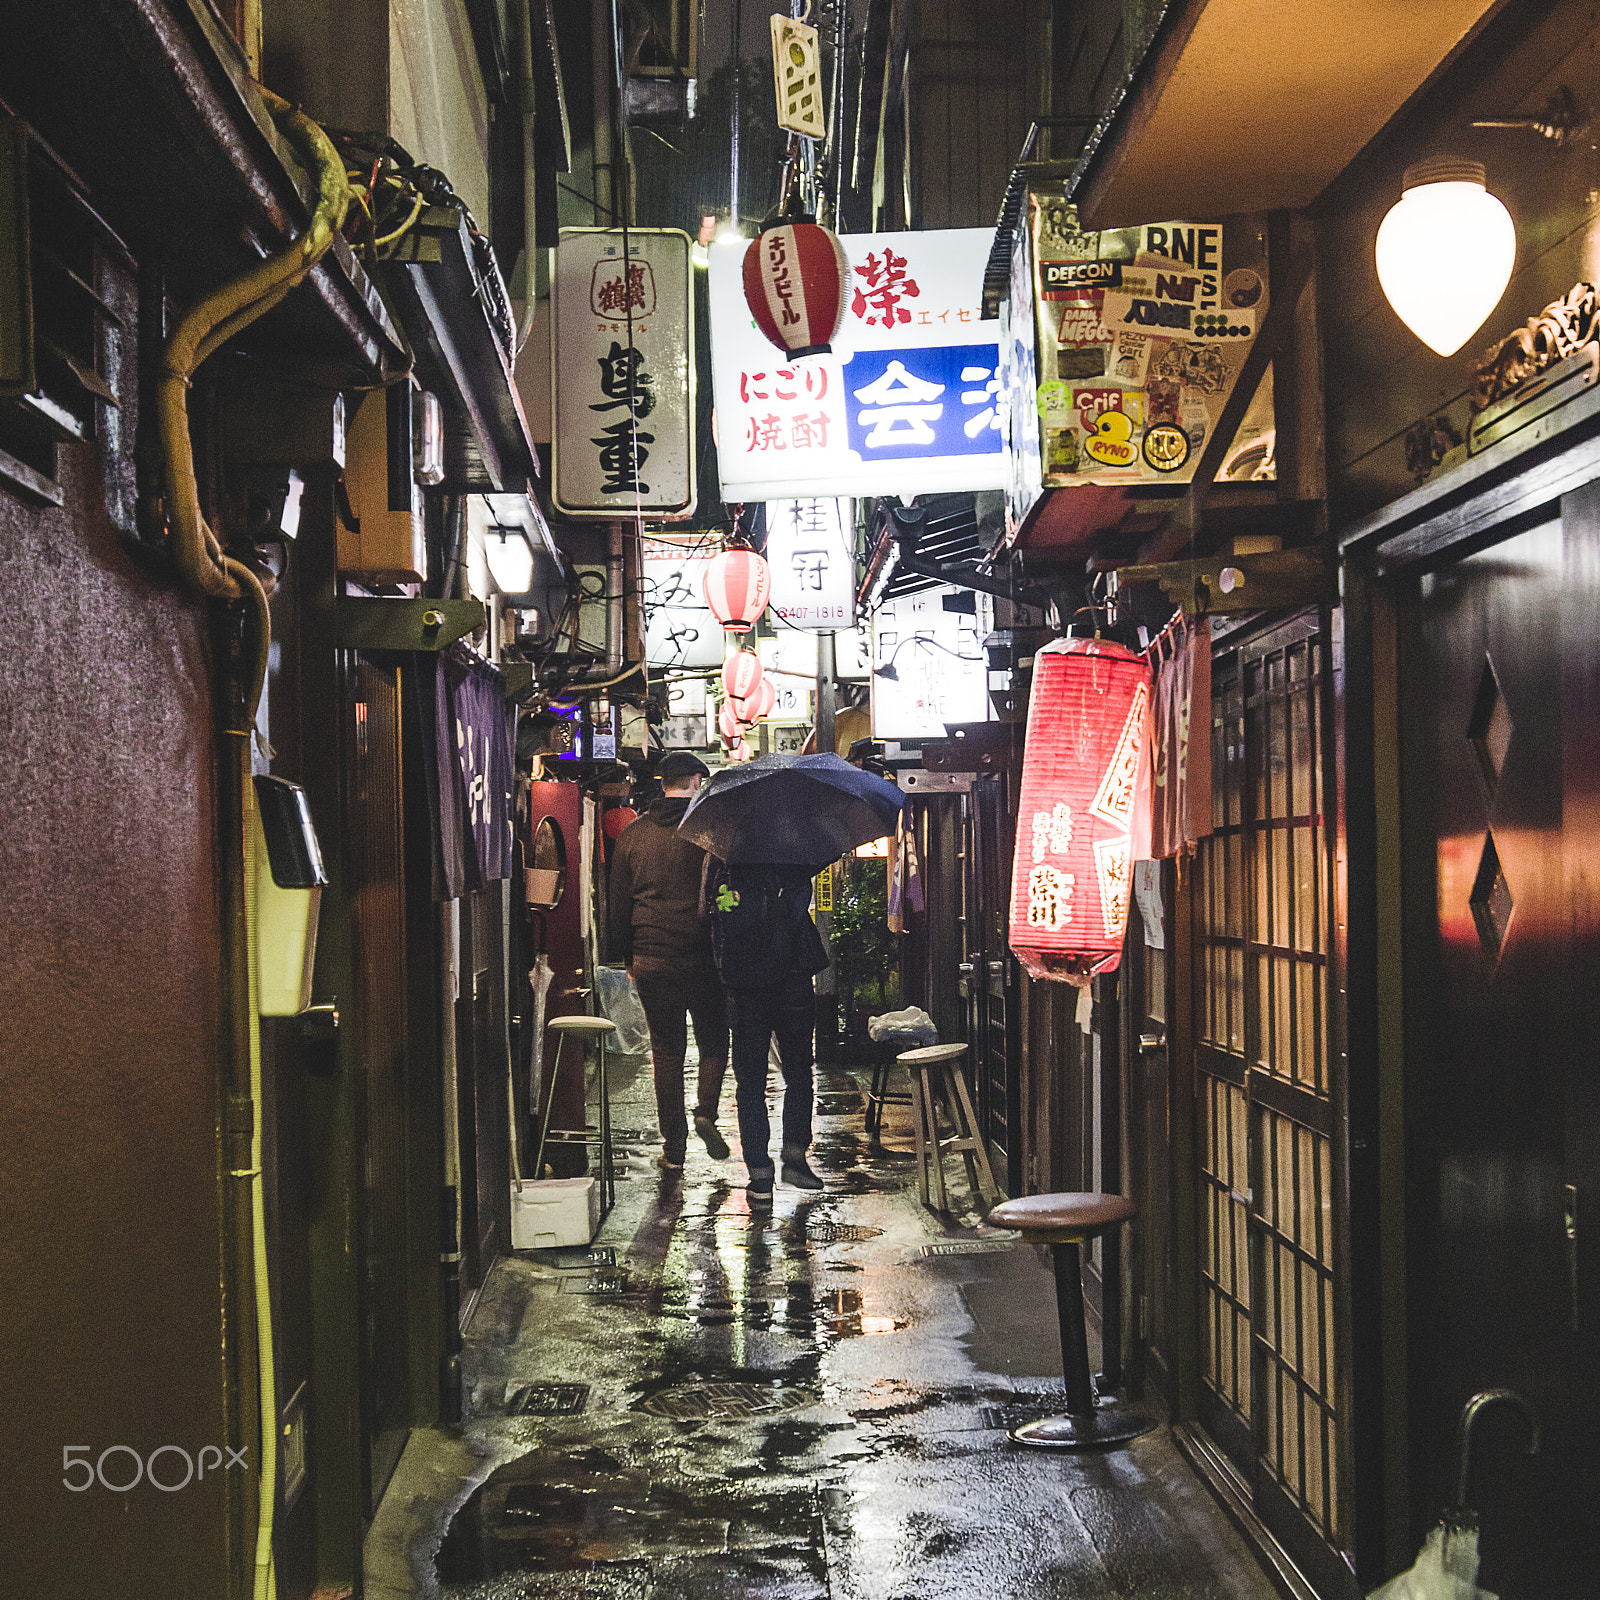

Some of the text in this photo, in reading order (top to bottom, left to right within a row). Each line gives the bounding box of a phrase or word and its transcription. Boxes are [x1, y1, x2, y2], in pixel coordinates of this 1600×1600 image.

[768, 235, 801, 326] キリンビール
[1047, 263, 1115, 282] DEFCON
[740, 365, 829, 403] にごり
[587, 341, 657, 494] 鳥重
[745, 410, 832, 453] 焼酎
[1092, 441, 1130, 459] RYNO
[788, 606, 845, 619] 407-1818
